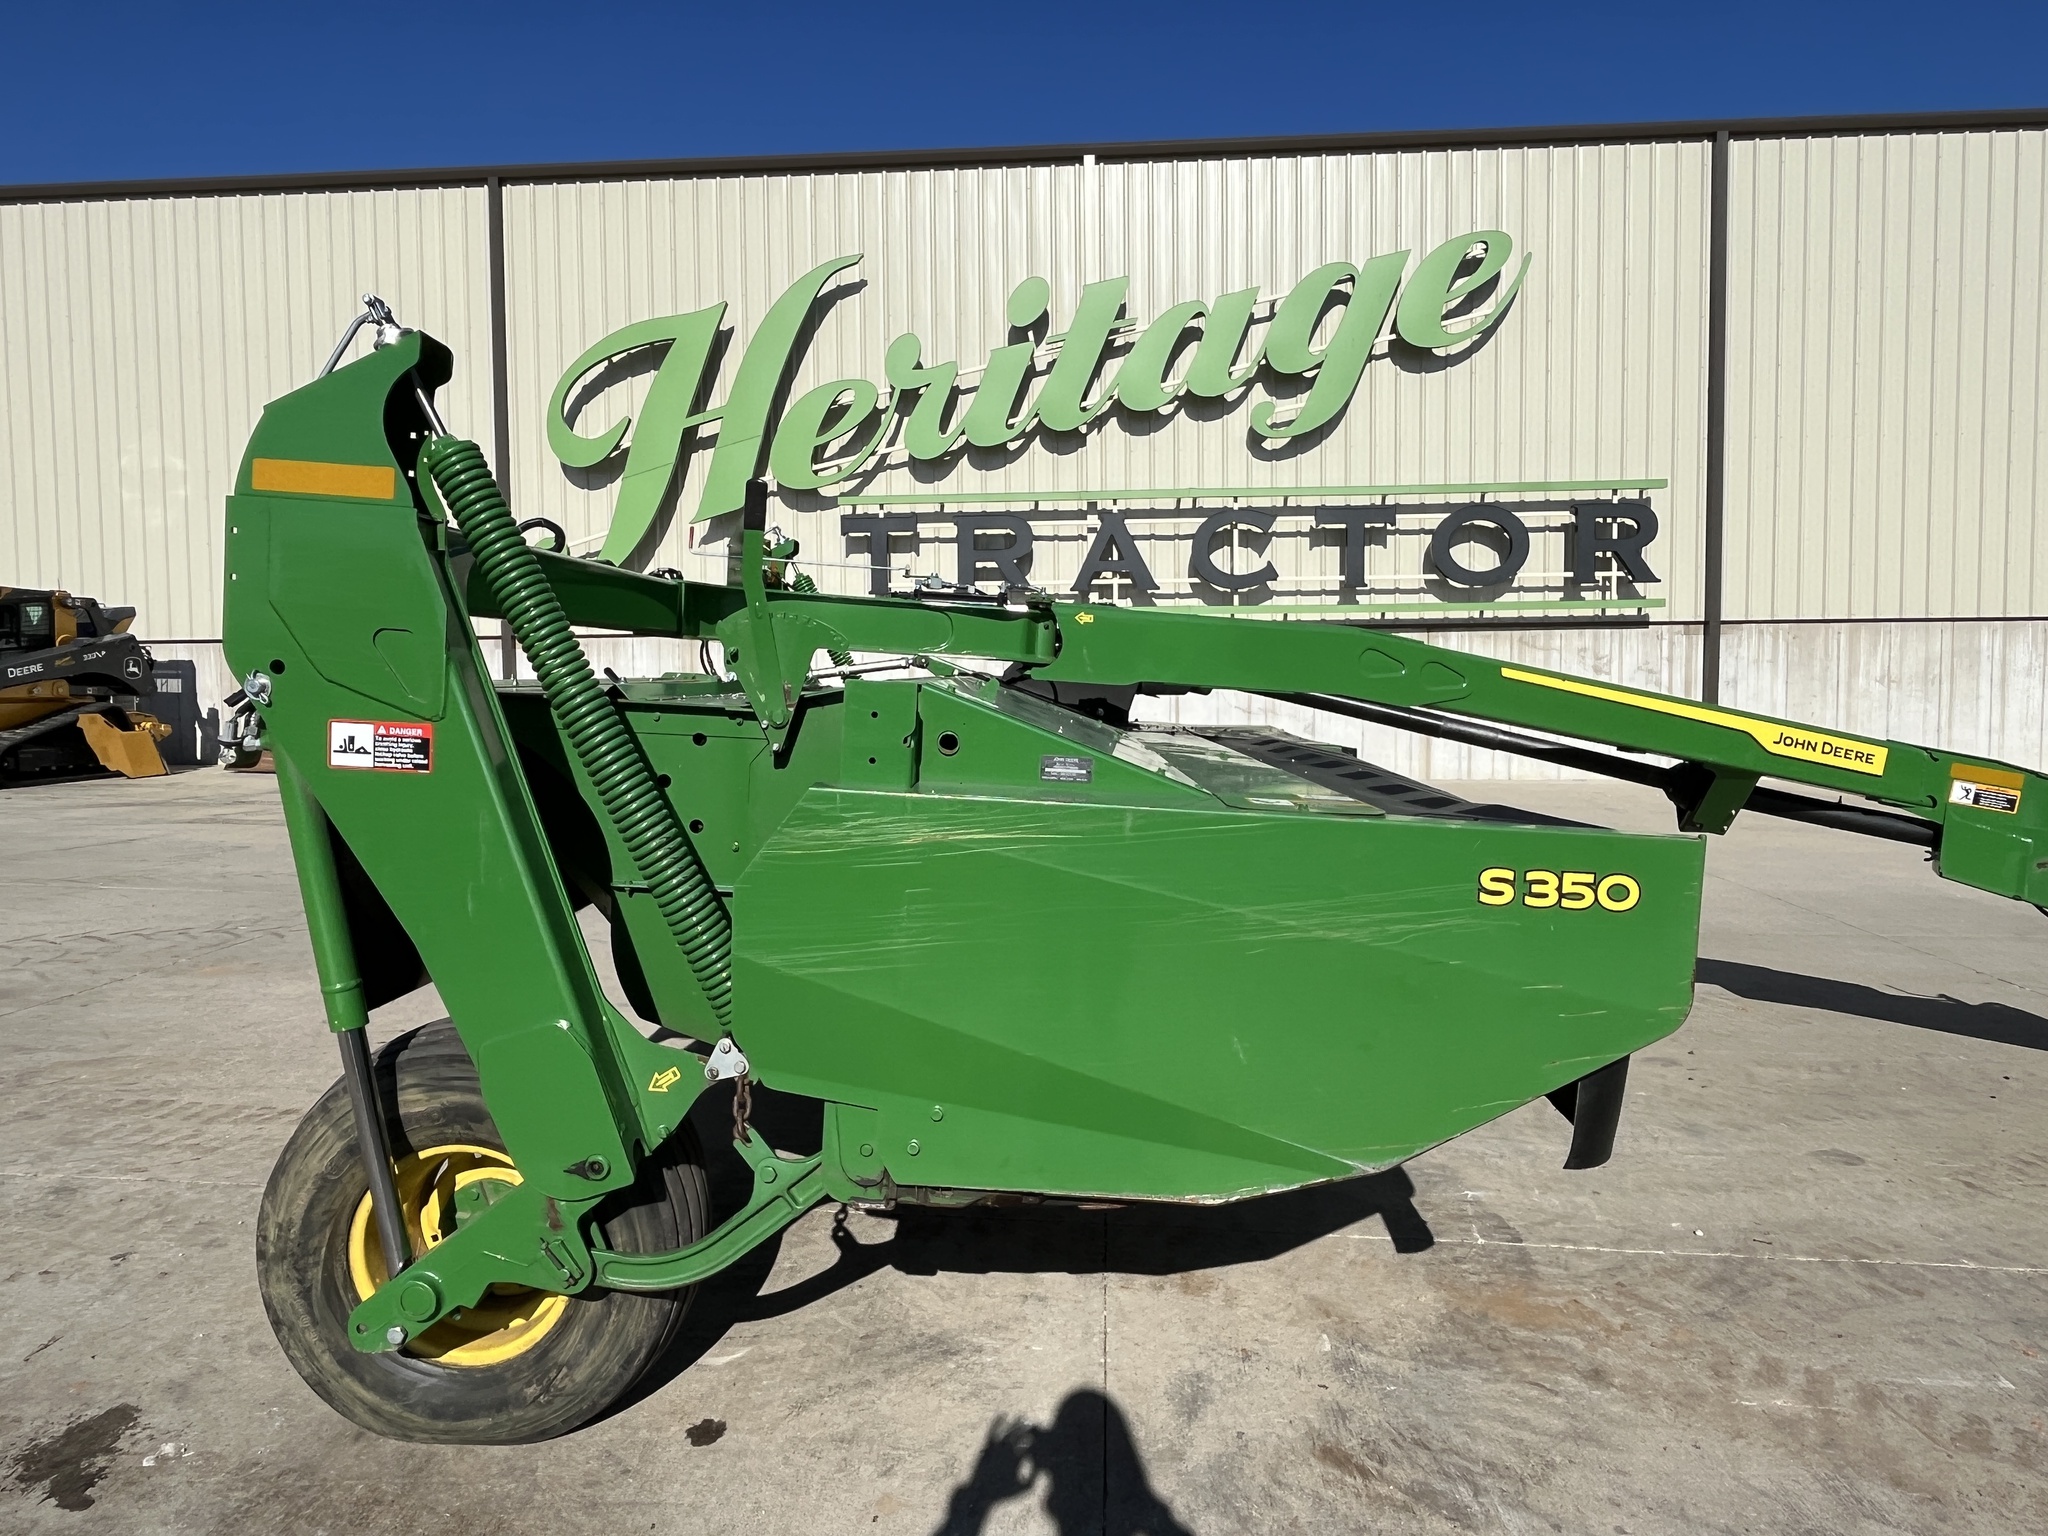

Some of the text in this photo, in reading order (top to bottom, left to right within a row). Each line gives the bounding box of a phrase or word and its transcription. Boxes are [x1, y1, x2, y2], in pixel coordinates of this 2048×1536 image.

[547, 230, 1531, 567] Heritage
[839, 502, 1660, 596] TRACTOR
[7, 663, 44, 678] DEERE
[389, 727, 423, 737] DANGER
[1773, 732, 1876, 765] JOHN DEERE
